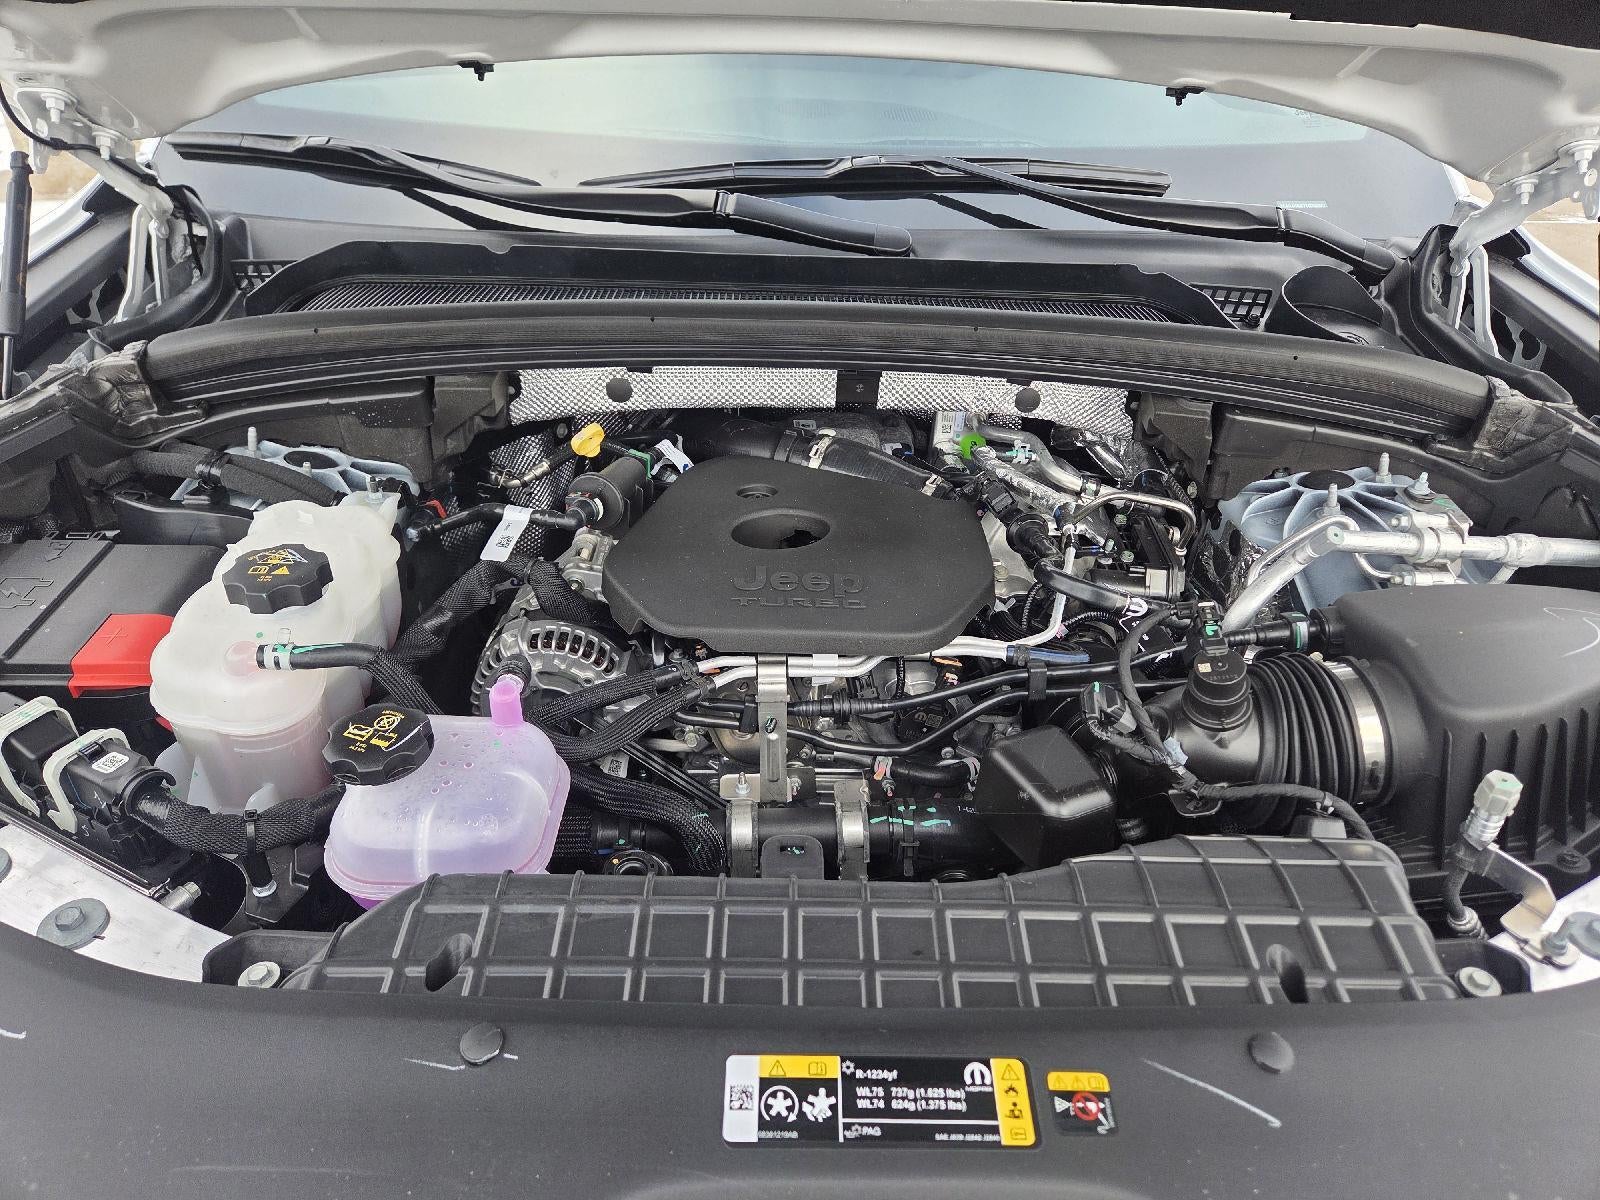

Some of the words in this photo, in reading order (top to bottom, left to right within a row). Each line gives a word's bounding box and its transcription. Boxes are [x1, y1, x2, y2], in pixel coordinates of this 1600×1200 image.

[734, 565, 864, 597] Jeep
[856, 1069, 898, 1081] R-1234yf
[856, 1086, 885, 1097] WL75
[890, 1087, 915, 1100] 737g
[856, 1098, 885, 1109] WL74
